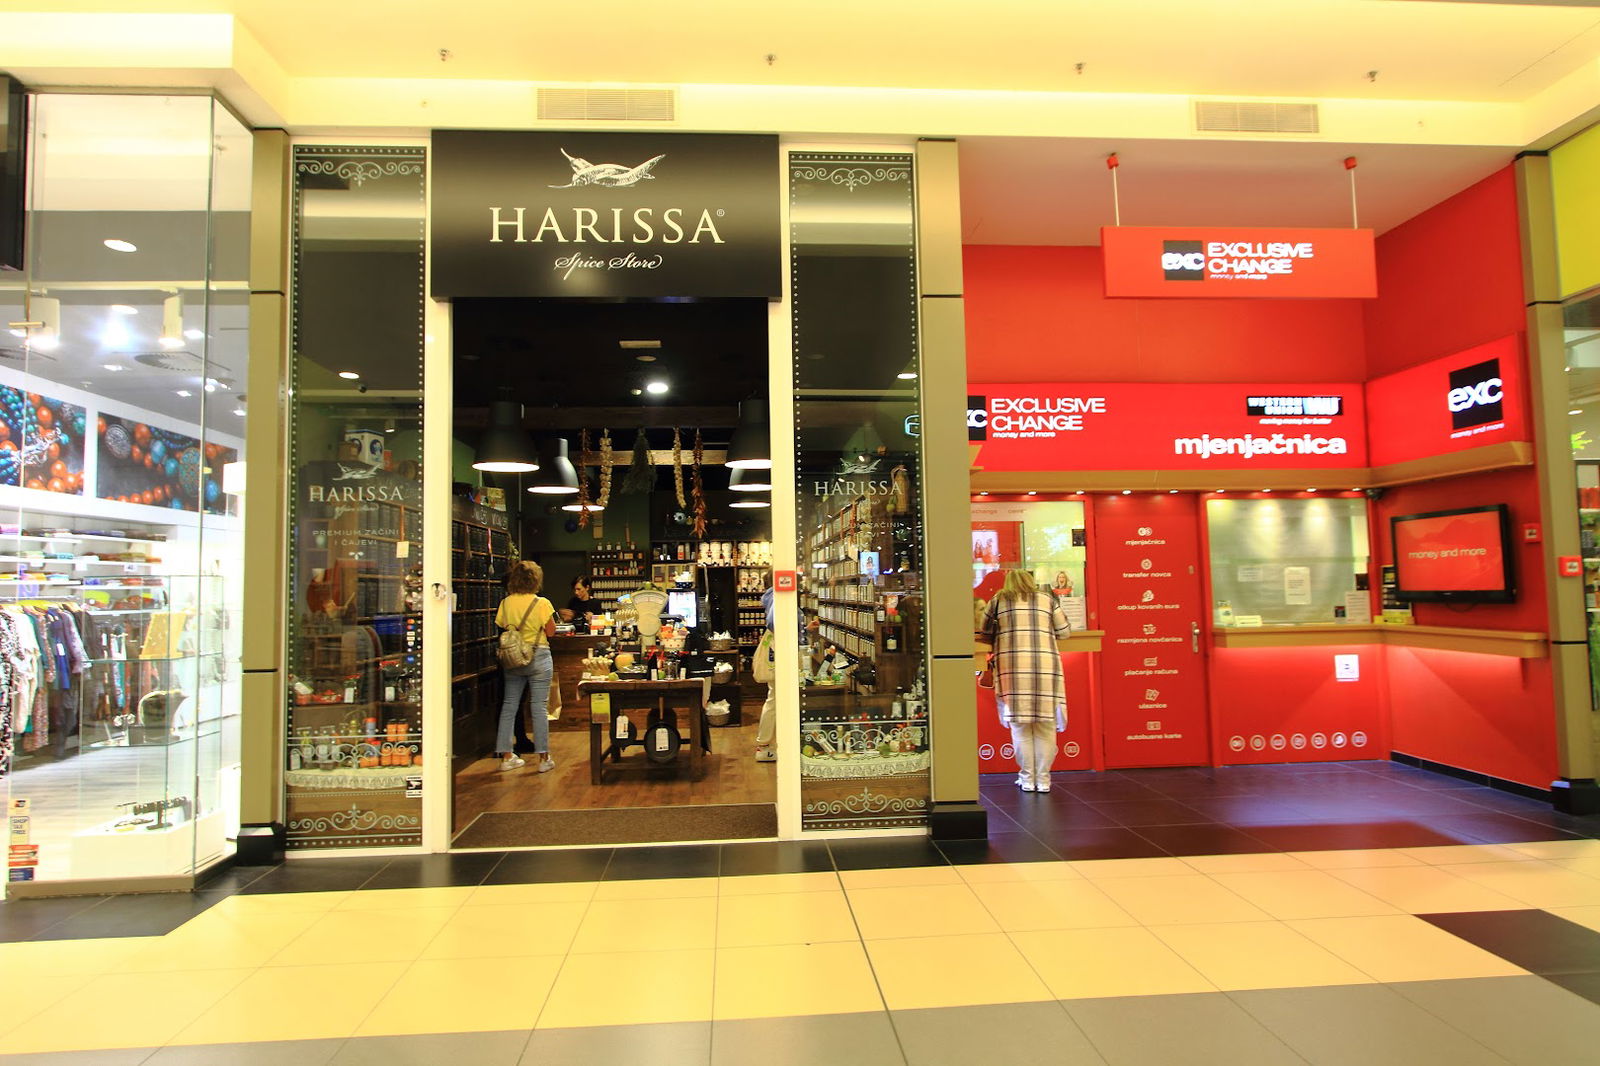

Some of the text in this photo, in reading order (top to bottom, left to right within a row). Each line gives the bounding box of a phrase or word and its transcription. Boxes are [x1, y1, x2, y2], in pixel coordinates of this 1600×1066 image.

[1207, 242, 1314, 258] EXCLUSIVE
[554, 252, 663, 281] Spice Store
[1207, 258, 1293, 274] CHANGE
[1447, 377, 1504, 413] exc
[991, 397, 1106, 413] EXCLUSIVE
[991, 415, 1084, 431] CHANGE
[1175, 433, 1346, 458] mjenjačnica
[309, 485, 404, 502] HARISSA
[814, 480, 903, 496] HARISSA
[312, 529, 361, 537] PREMIUM
[1408, 547, 1487, 560] money and more
